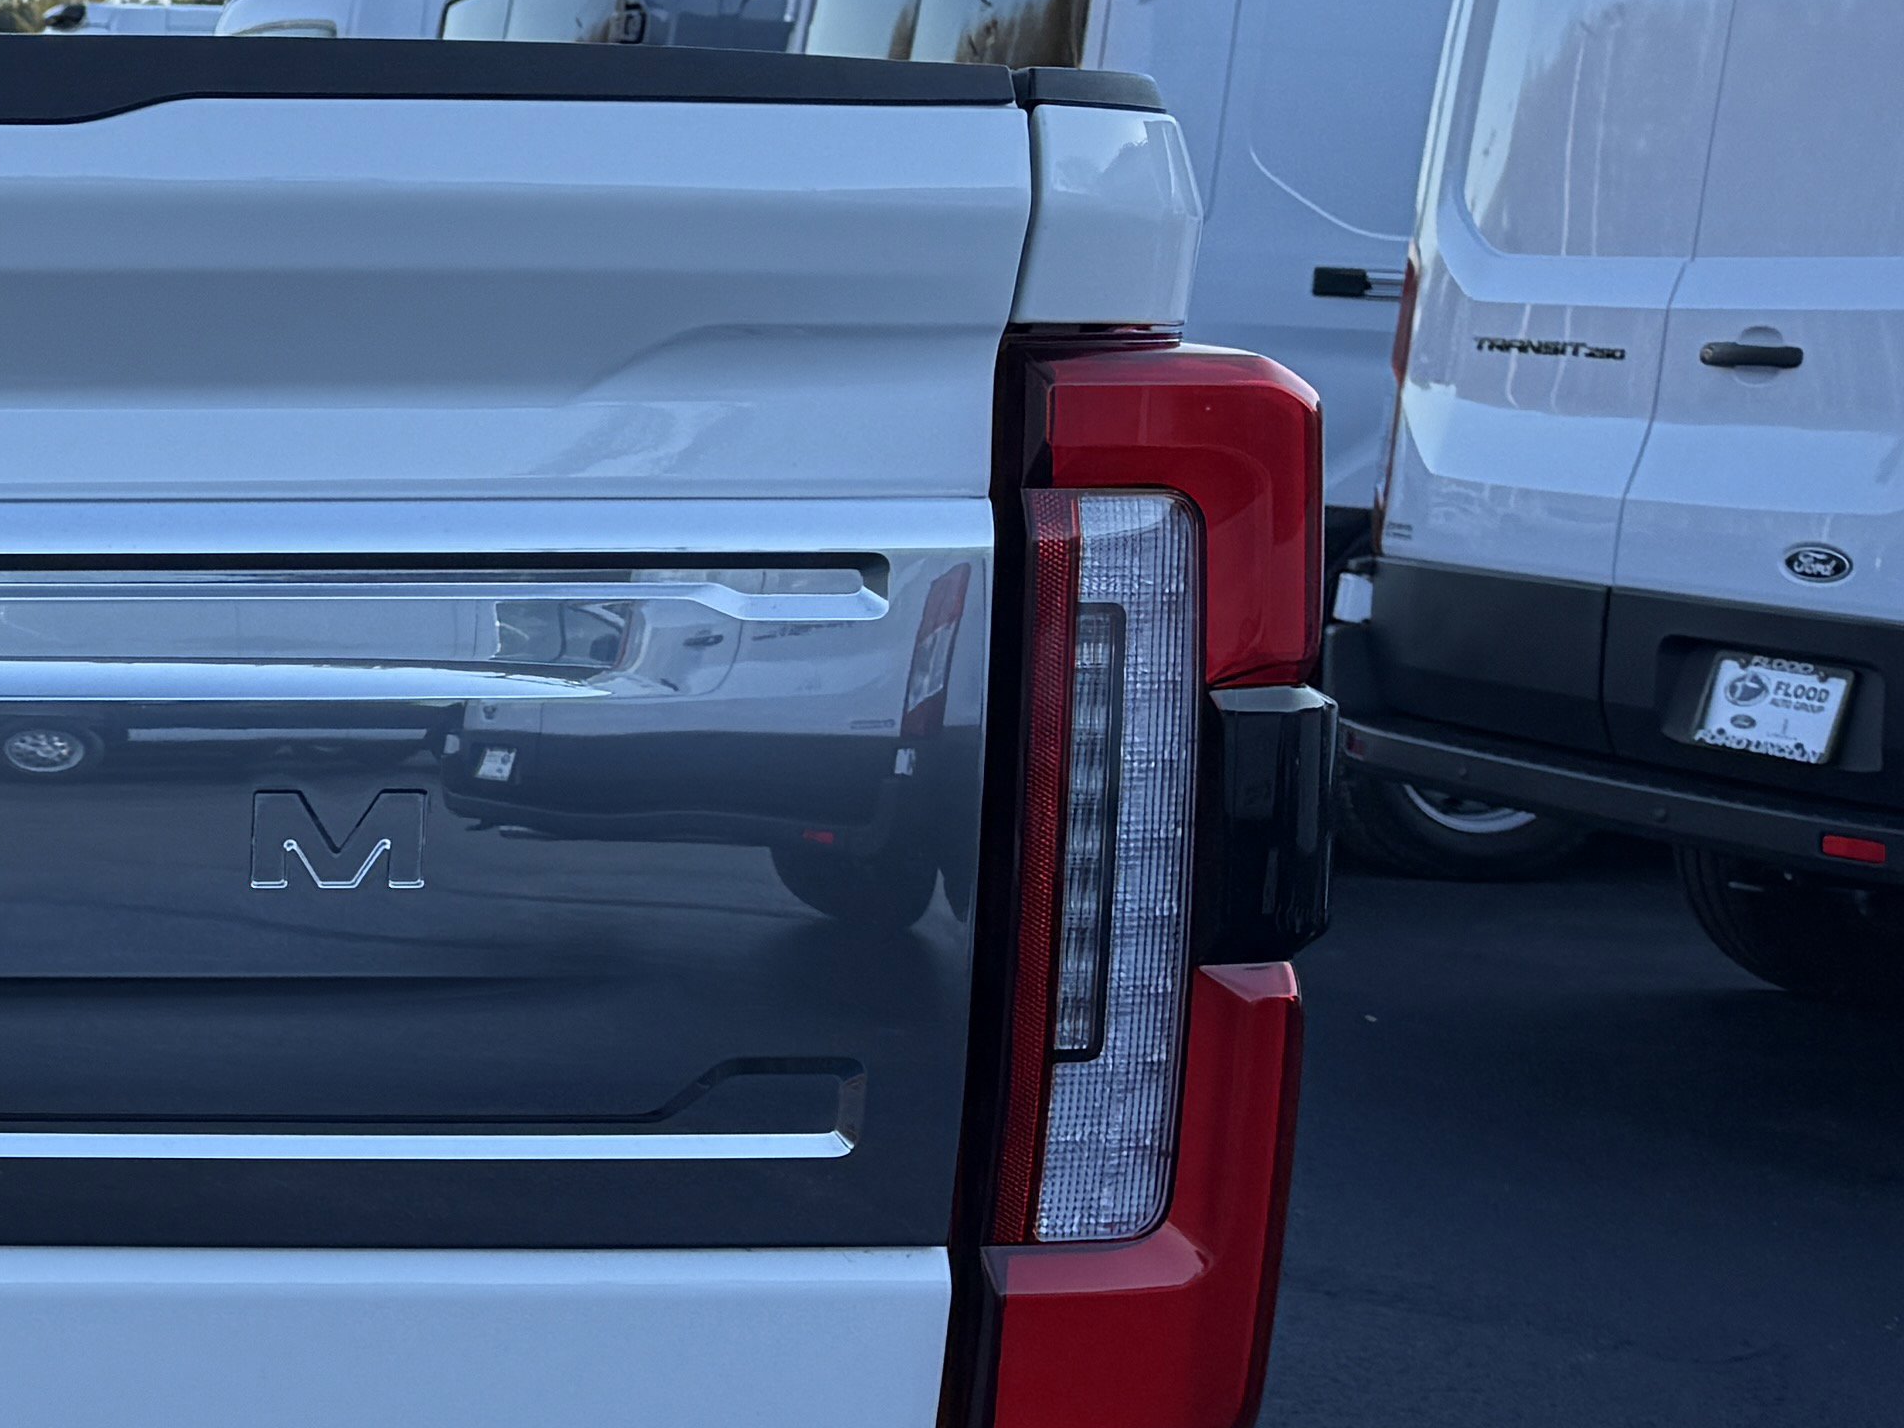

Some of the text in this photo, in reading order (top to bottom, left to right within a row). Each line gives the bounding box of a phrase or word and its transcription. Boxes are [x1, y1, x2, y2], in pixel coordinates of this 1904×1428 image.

[1472, 337, 1588, 357] TRANSIT
[1793, 551, 1837, 576] Ford
[1773, 680, 1830, 704] FLOOD
